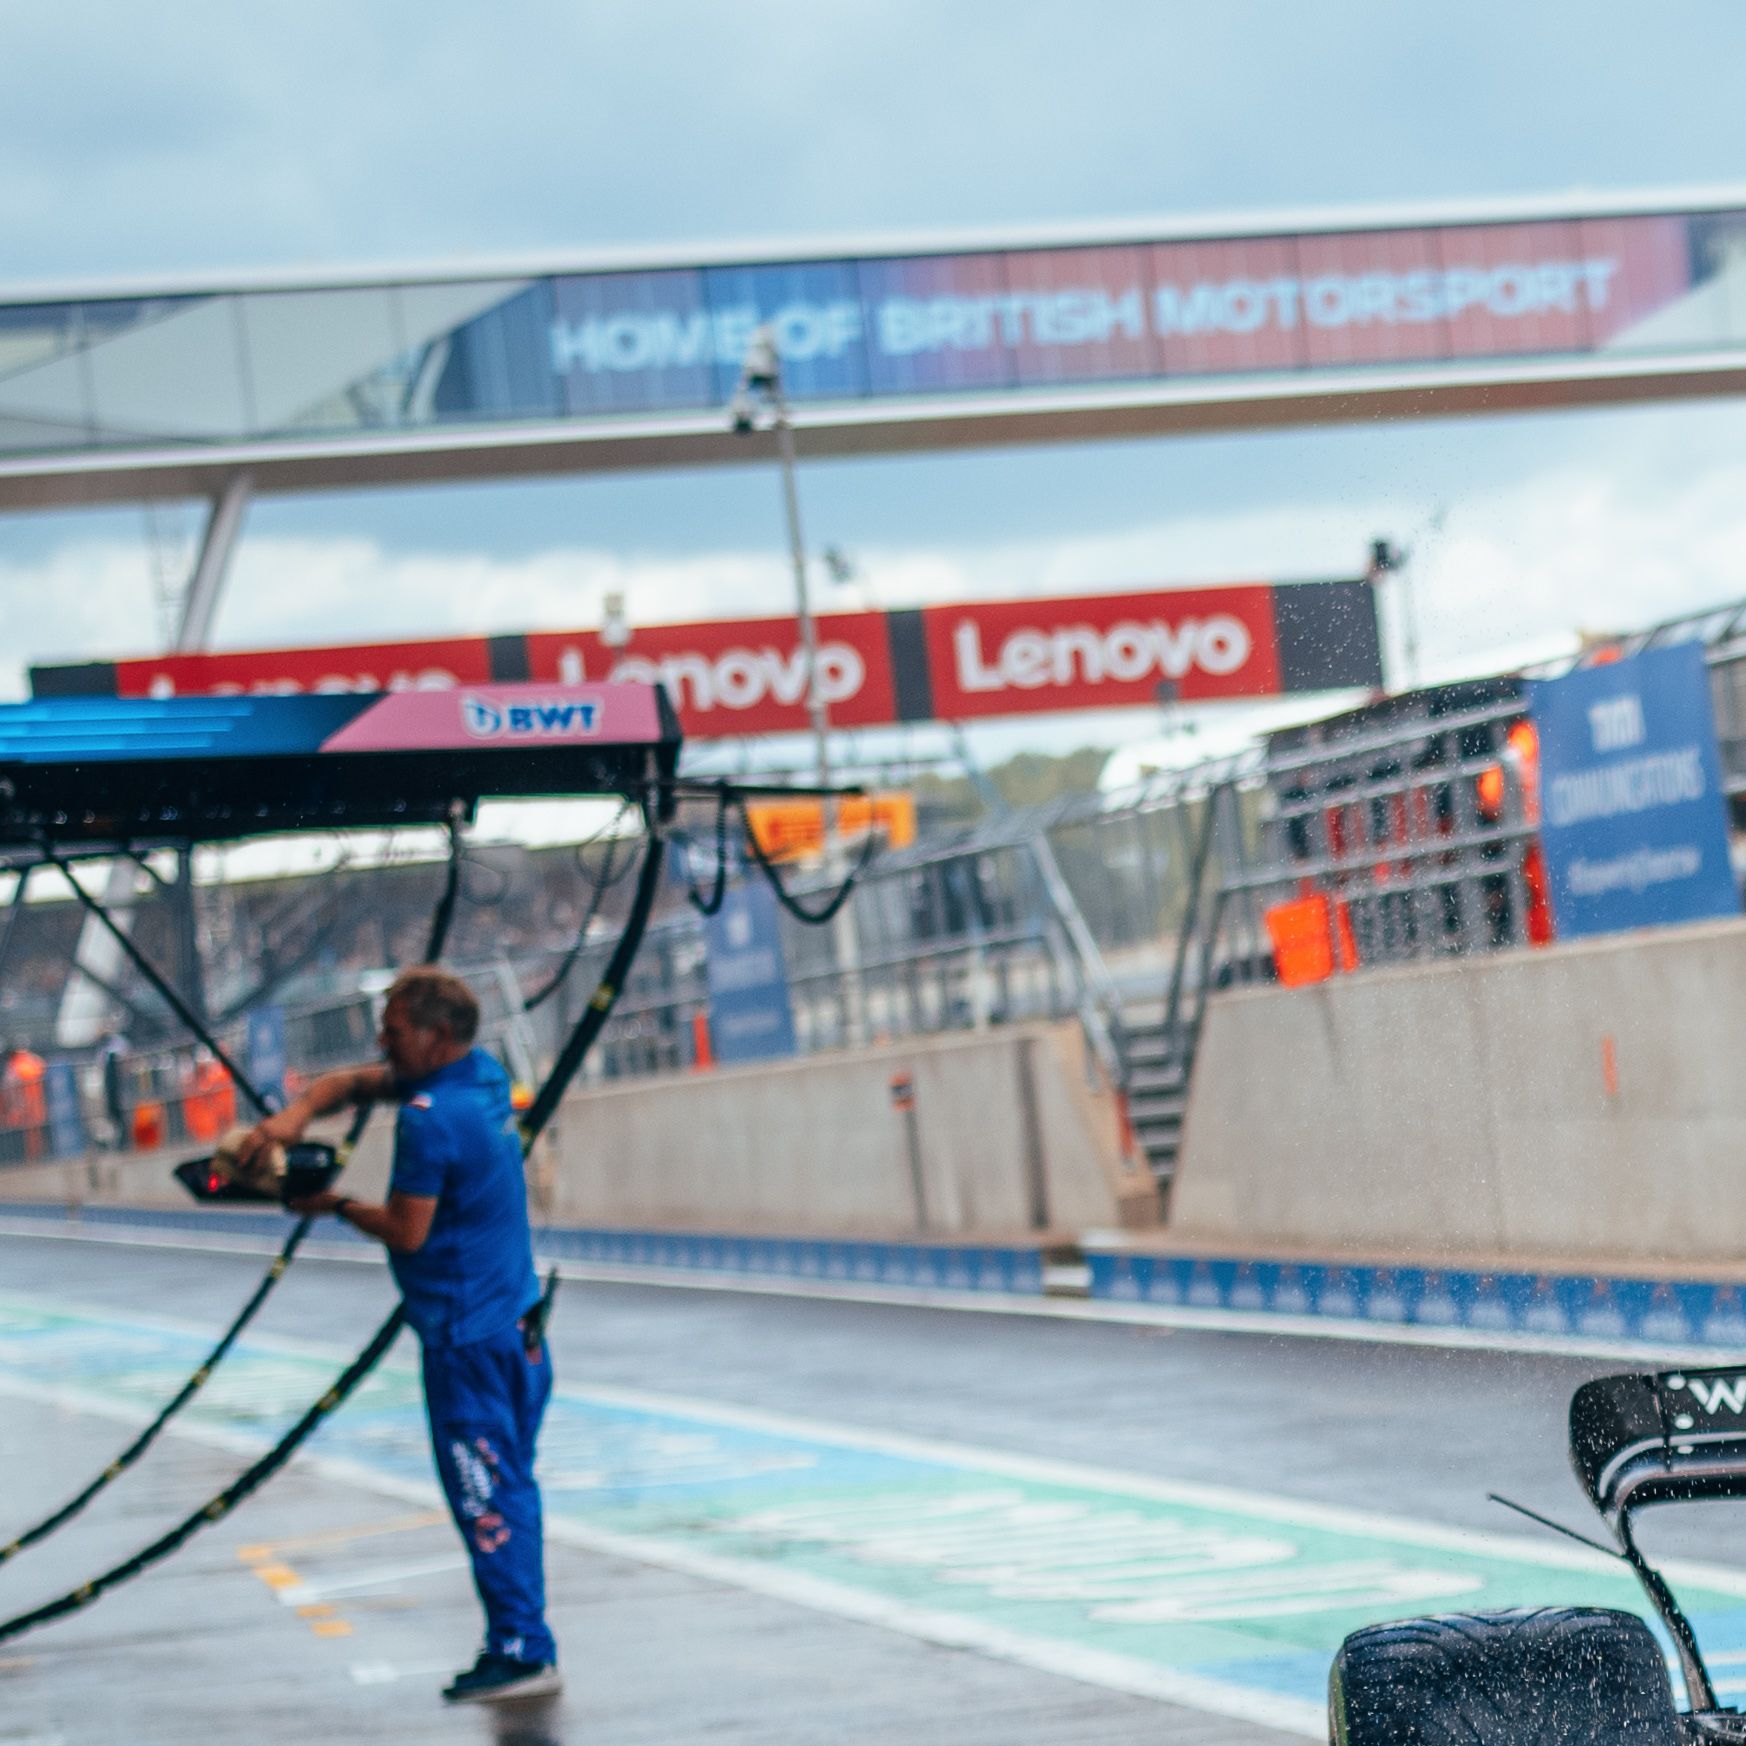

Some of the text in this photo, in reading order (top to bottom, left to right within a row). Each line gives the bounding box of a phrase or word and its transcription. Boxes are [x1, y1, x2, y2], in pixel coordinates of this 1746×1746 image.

[551, 259, 1618, 376] HOME OF BRITISH MOTORSPORT
[953, 613, 1254, 693] Lenovo
[507, 702, 597, 733] BWT
